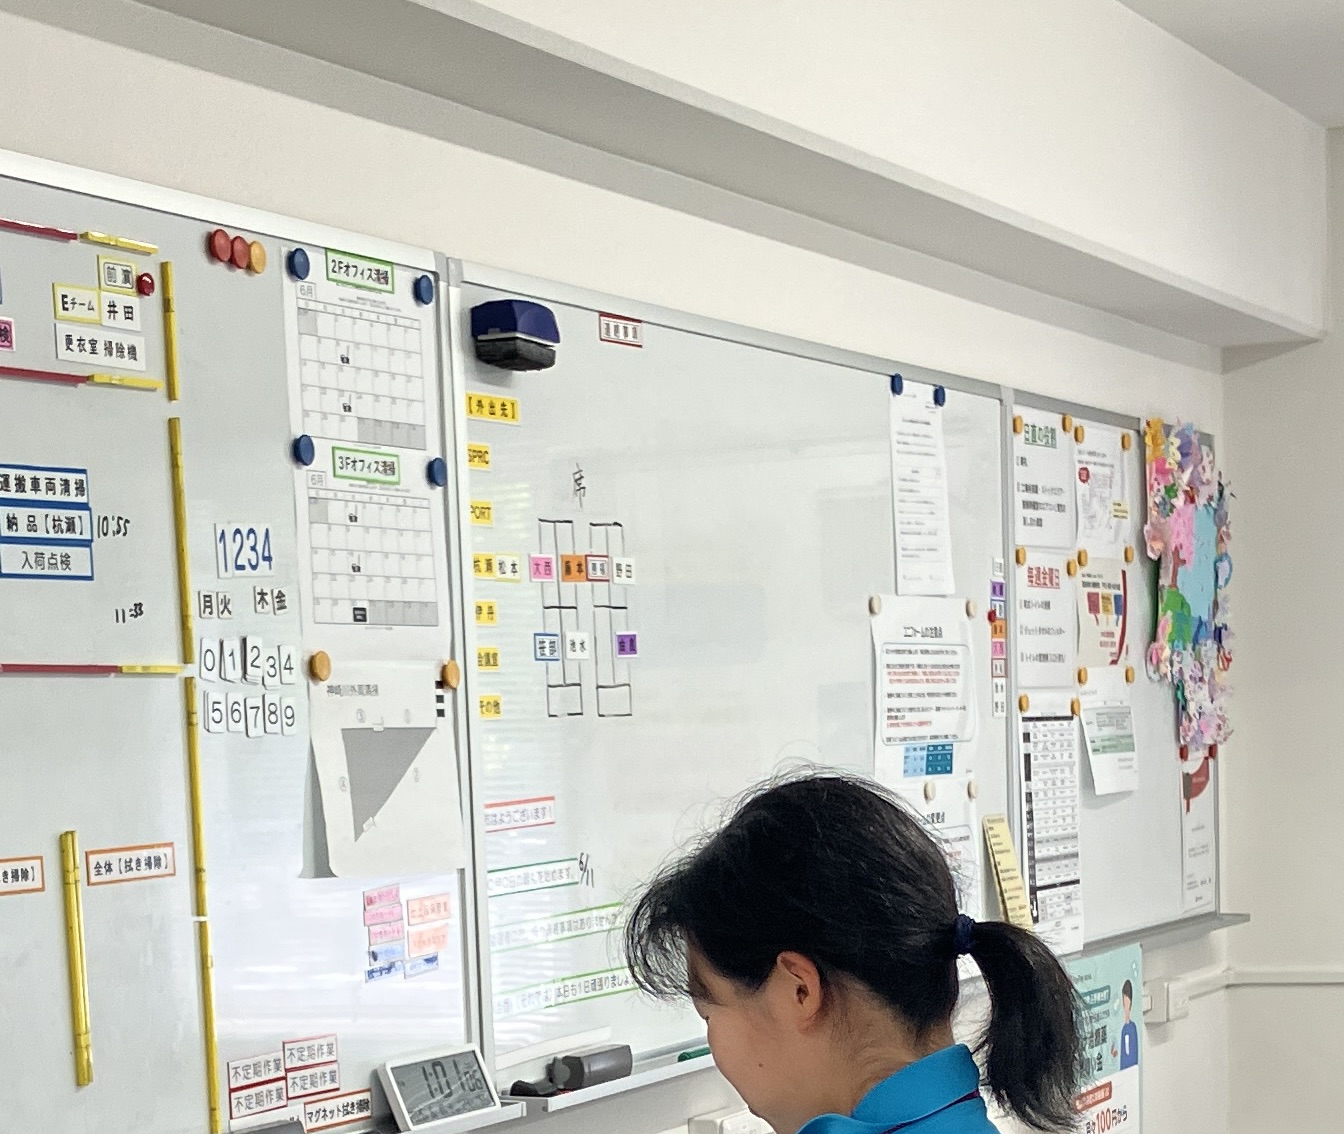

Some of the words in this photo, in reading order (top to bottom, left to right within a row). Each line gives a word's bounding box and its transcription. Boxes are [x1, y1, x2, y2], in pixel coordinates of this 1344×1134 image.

[61, 294, 94, 311] Eチーム
[107, 300, 133, 320] 井田
[21, 551, 71, 571] 入荷点検
[287, 1043, 335, 1064] 不定期作業
[232, 1060, 282, 1083] 不定期作業
[290, 1070, 337, 1091] 不定期作業
[234, 1087, 285, 1110] 不定期作業
